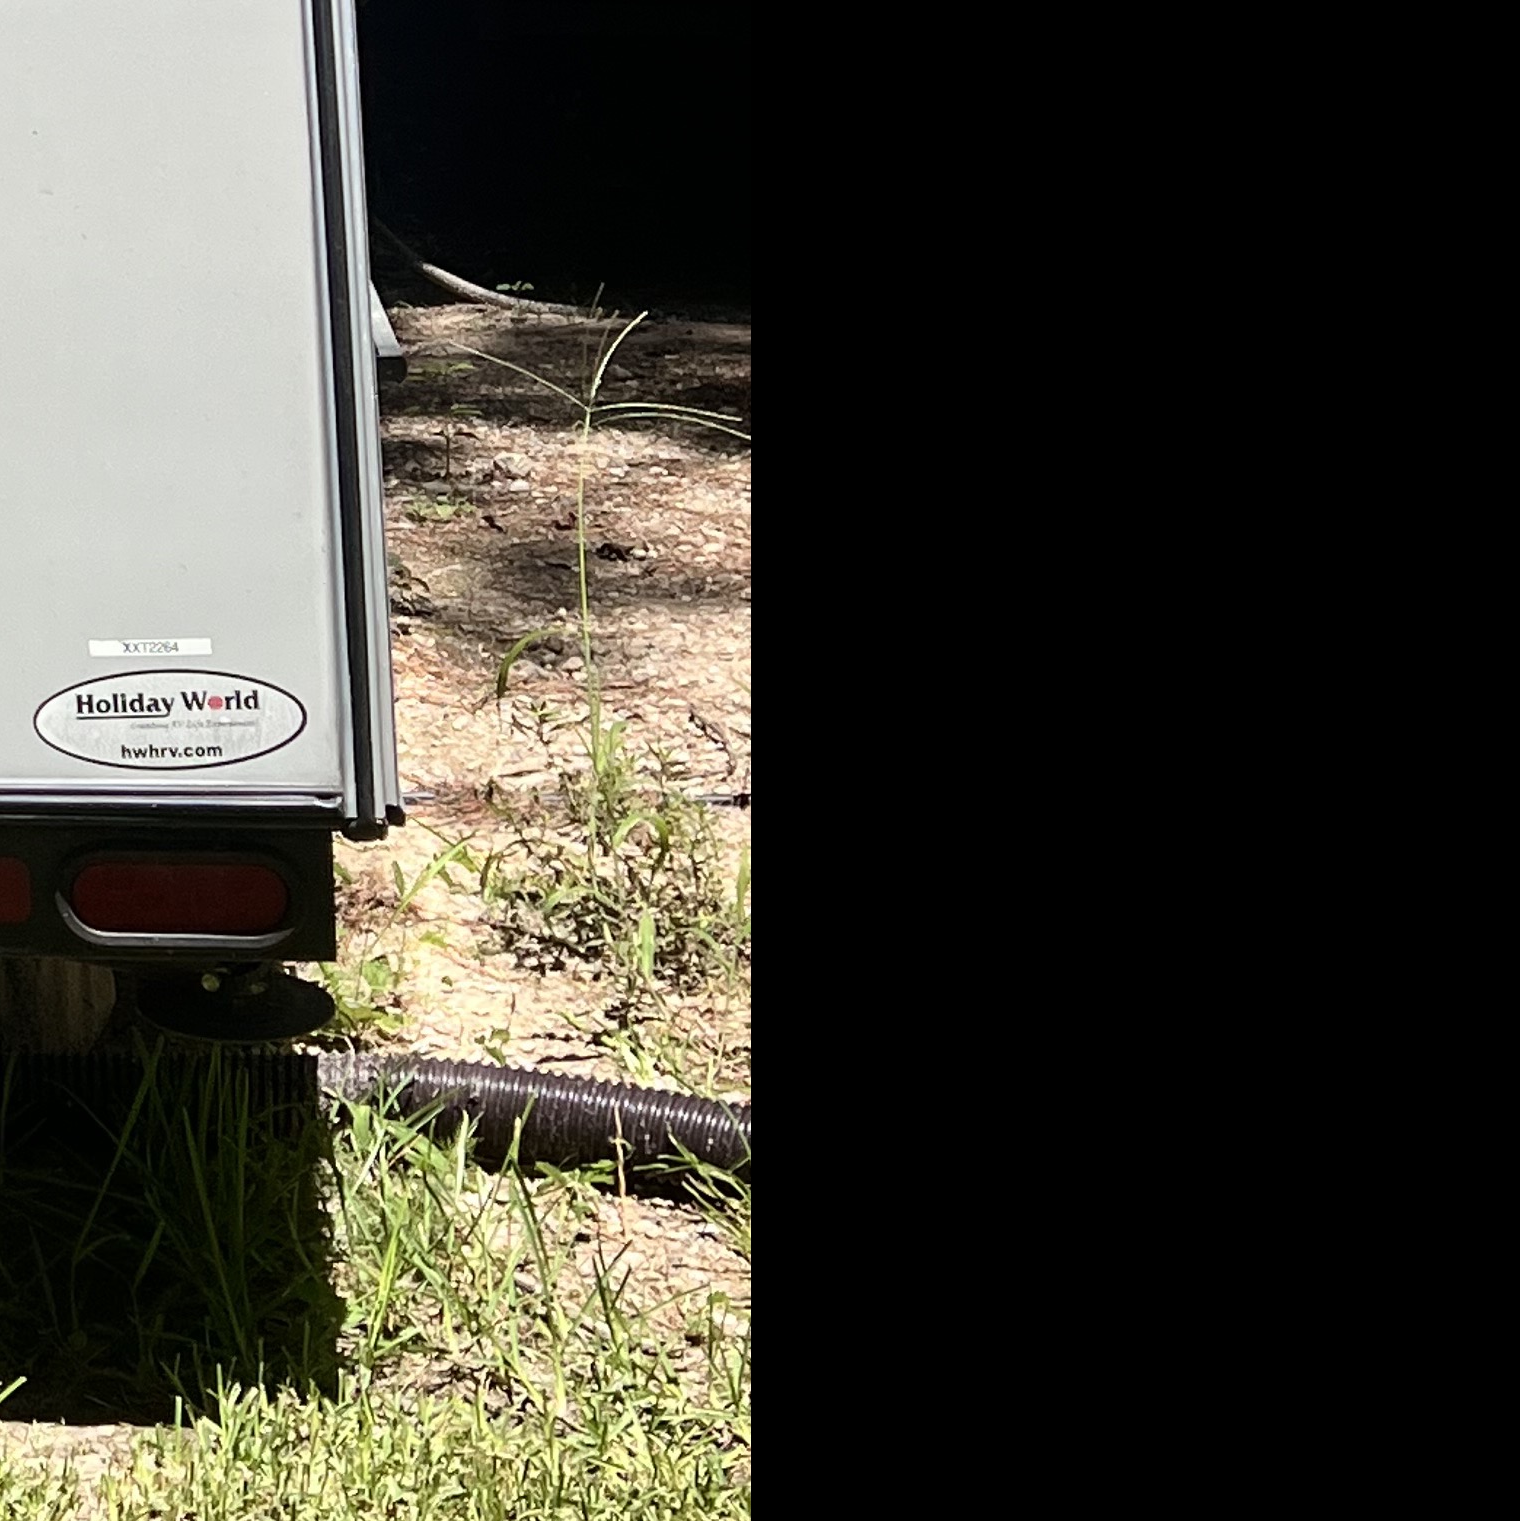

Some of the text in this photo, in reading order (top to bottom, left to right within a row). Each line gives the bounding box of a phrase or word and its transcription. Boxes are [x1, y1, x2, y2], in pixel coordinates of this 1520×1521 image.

[75, 690, 260, 715] Holiday World
[120, 743, 224, 760] hwhrv.com
